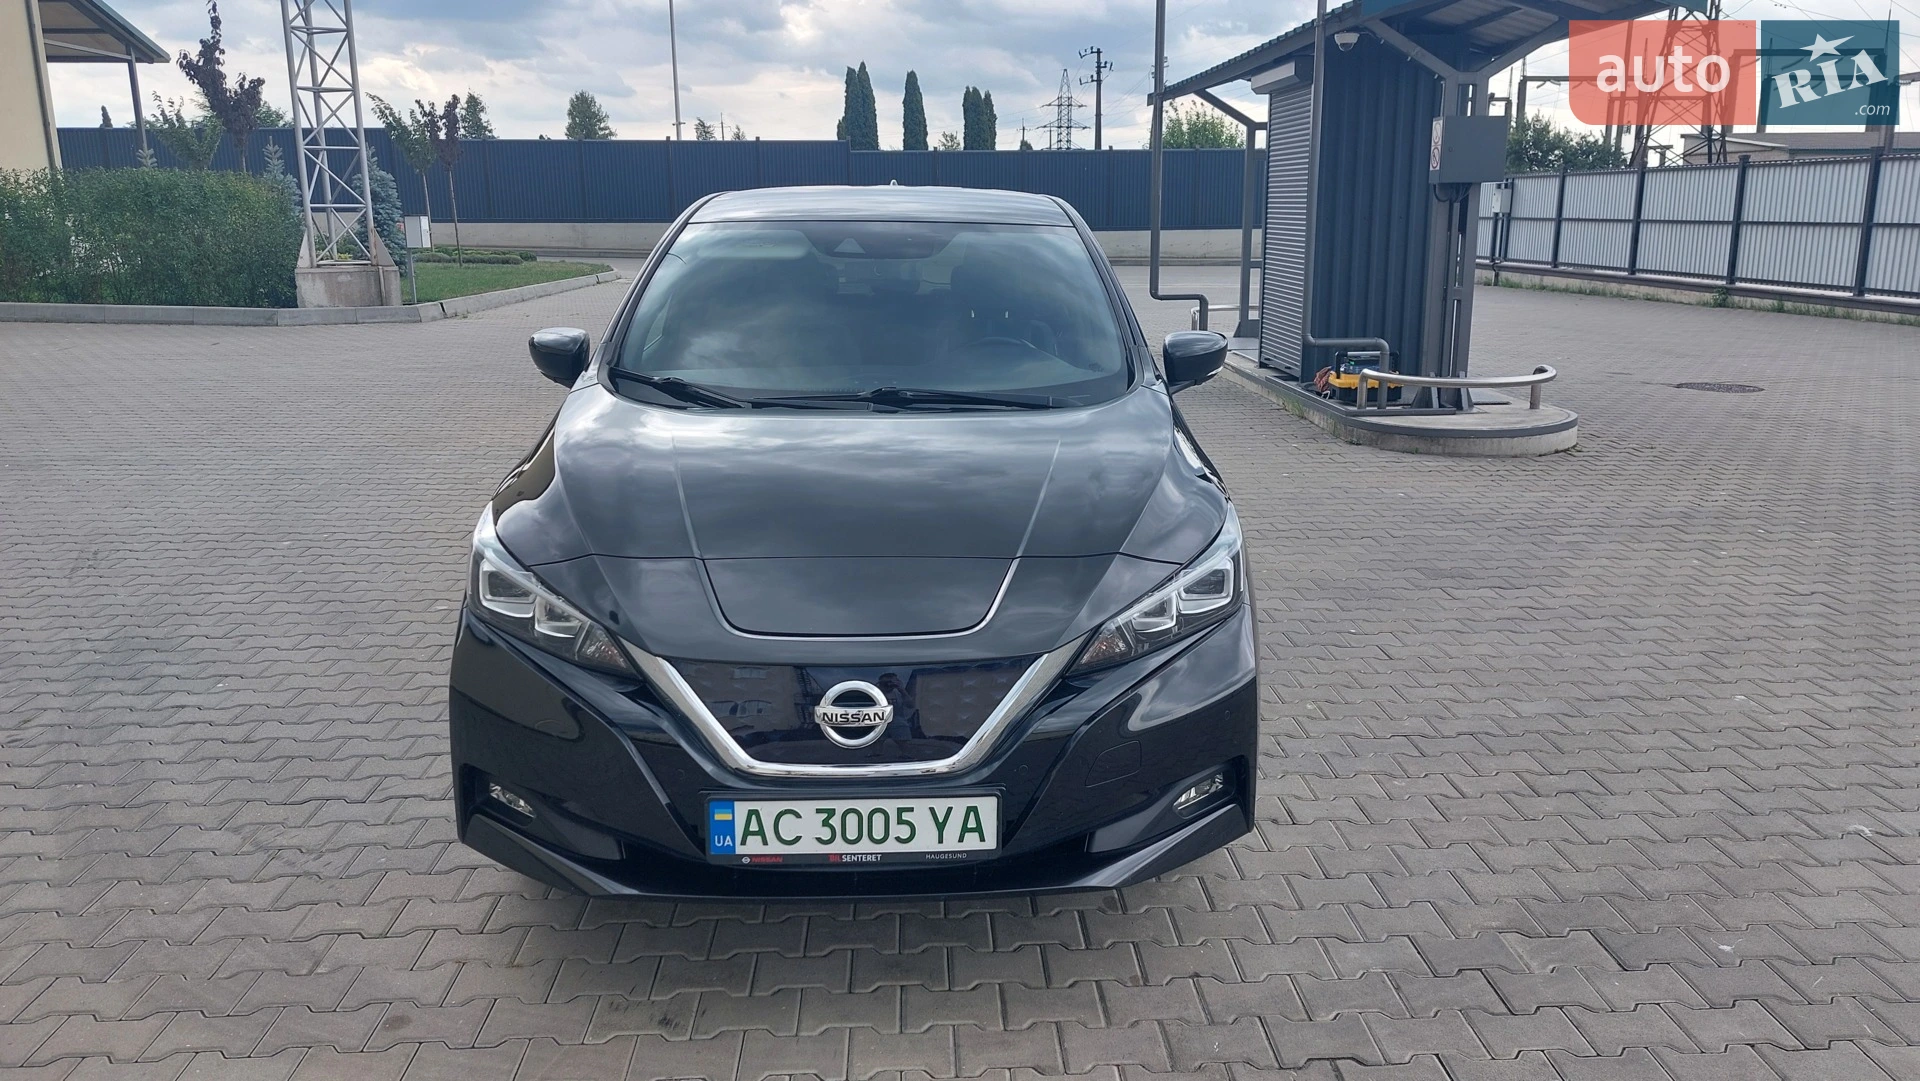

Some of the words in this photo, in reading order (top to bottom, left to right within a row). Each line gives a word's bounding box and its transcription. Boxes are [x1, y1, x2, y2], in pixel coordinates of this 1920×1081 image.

[822, 711, 885, 723] NISSAN
[740, 808, 803, 846] AC
[815, 806, 917, 846] 3005
[928, 805, 986, 844] YA
[714, 835, 733, 847] UA
